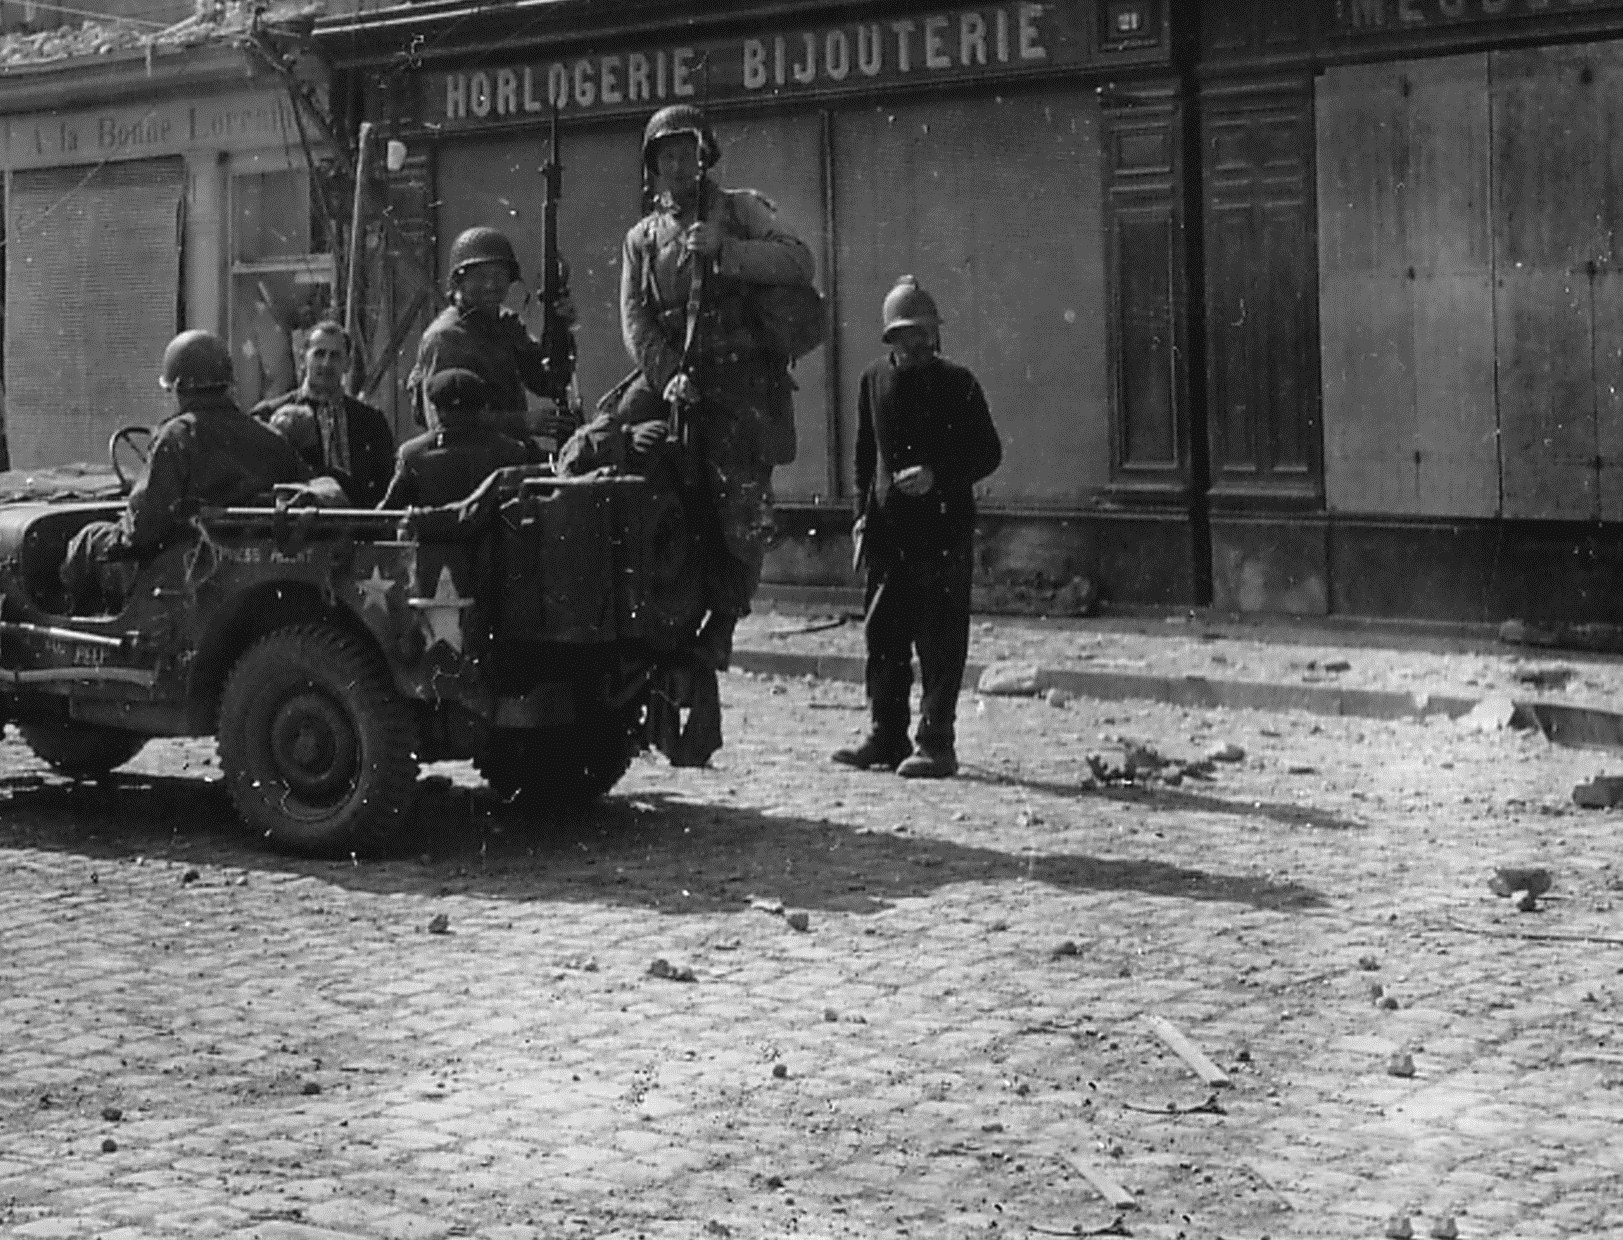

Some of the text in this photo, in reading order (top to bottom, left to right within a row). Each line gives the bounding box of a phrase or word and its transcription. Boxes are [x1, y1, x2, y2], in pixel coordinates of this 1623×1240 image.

[445, 3, 1047, 118] HORLOGERIE BIJOUTERIE
[97, 114, 172, 148] Bonne
